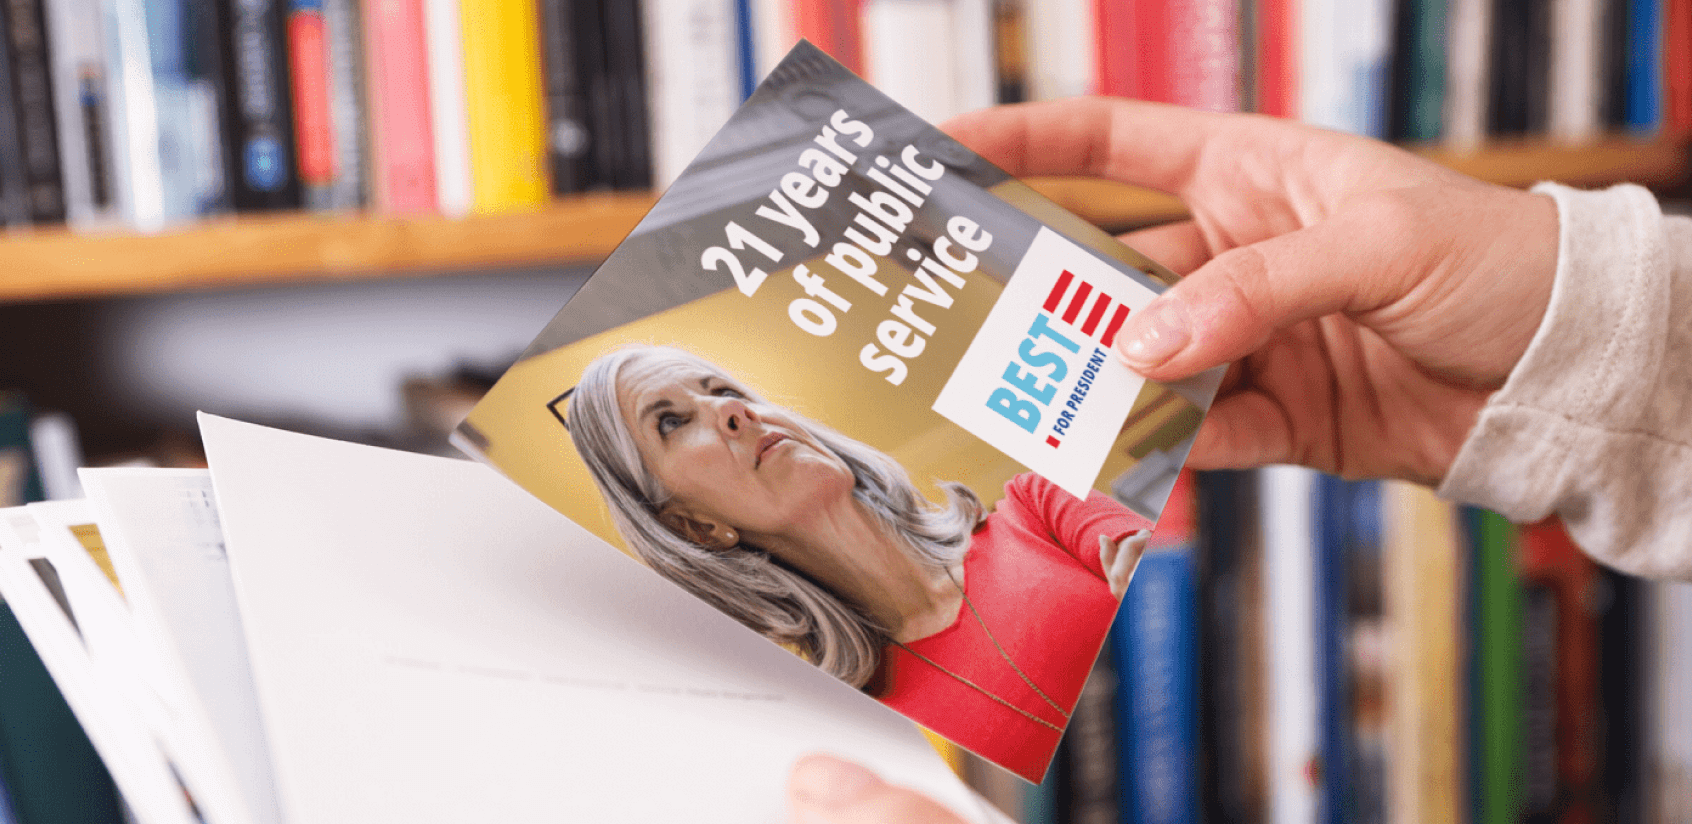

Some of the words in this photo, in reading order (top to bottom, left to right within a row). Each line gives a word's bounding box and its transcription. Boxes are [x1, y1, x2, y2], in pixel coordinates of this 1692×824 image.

[701, 221, 784, 298] 21
[755, 109, 874, 248] years
[788, 263, 852, 337] of
[824, 144, 945, 297] public
[859, 216, 993, 386] service
[985, 312, 1081, 434] BEST
[1052, 409, 1076, 436] FOR
[1065, 347, 1107, 411] PRESIDENT
